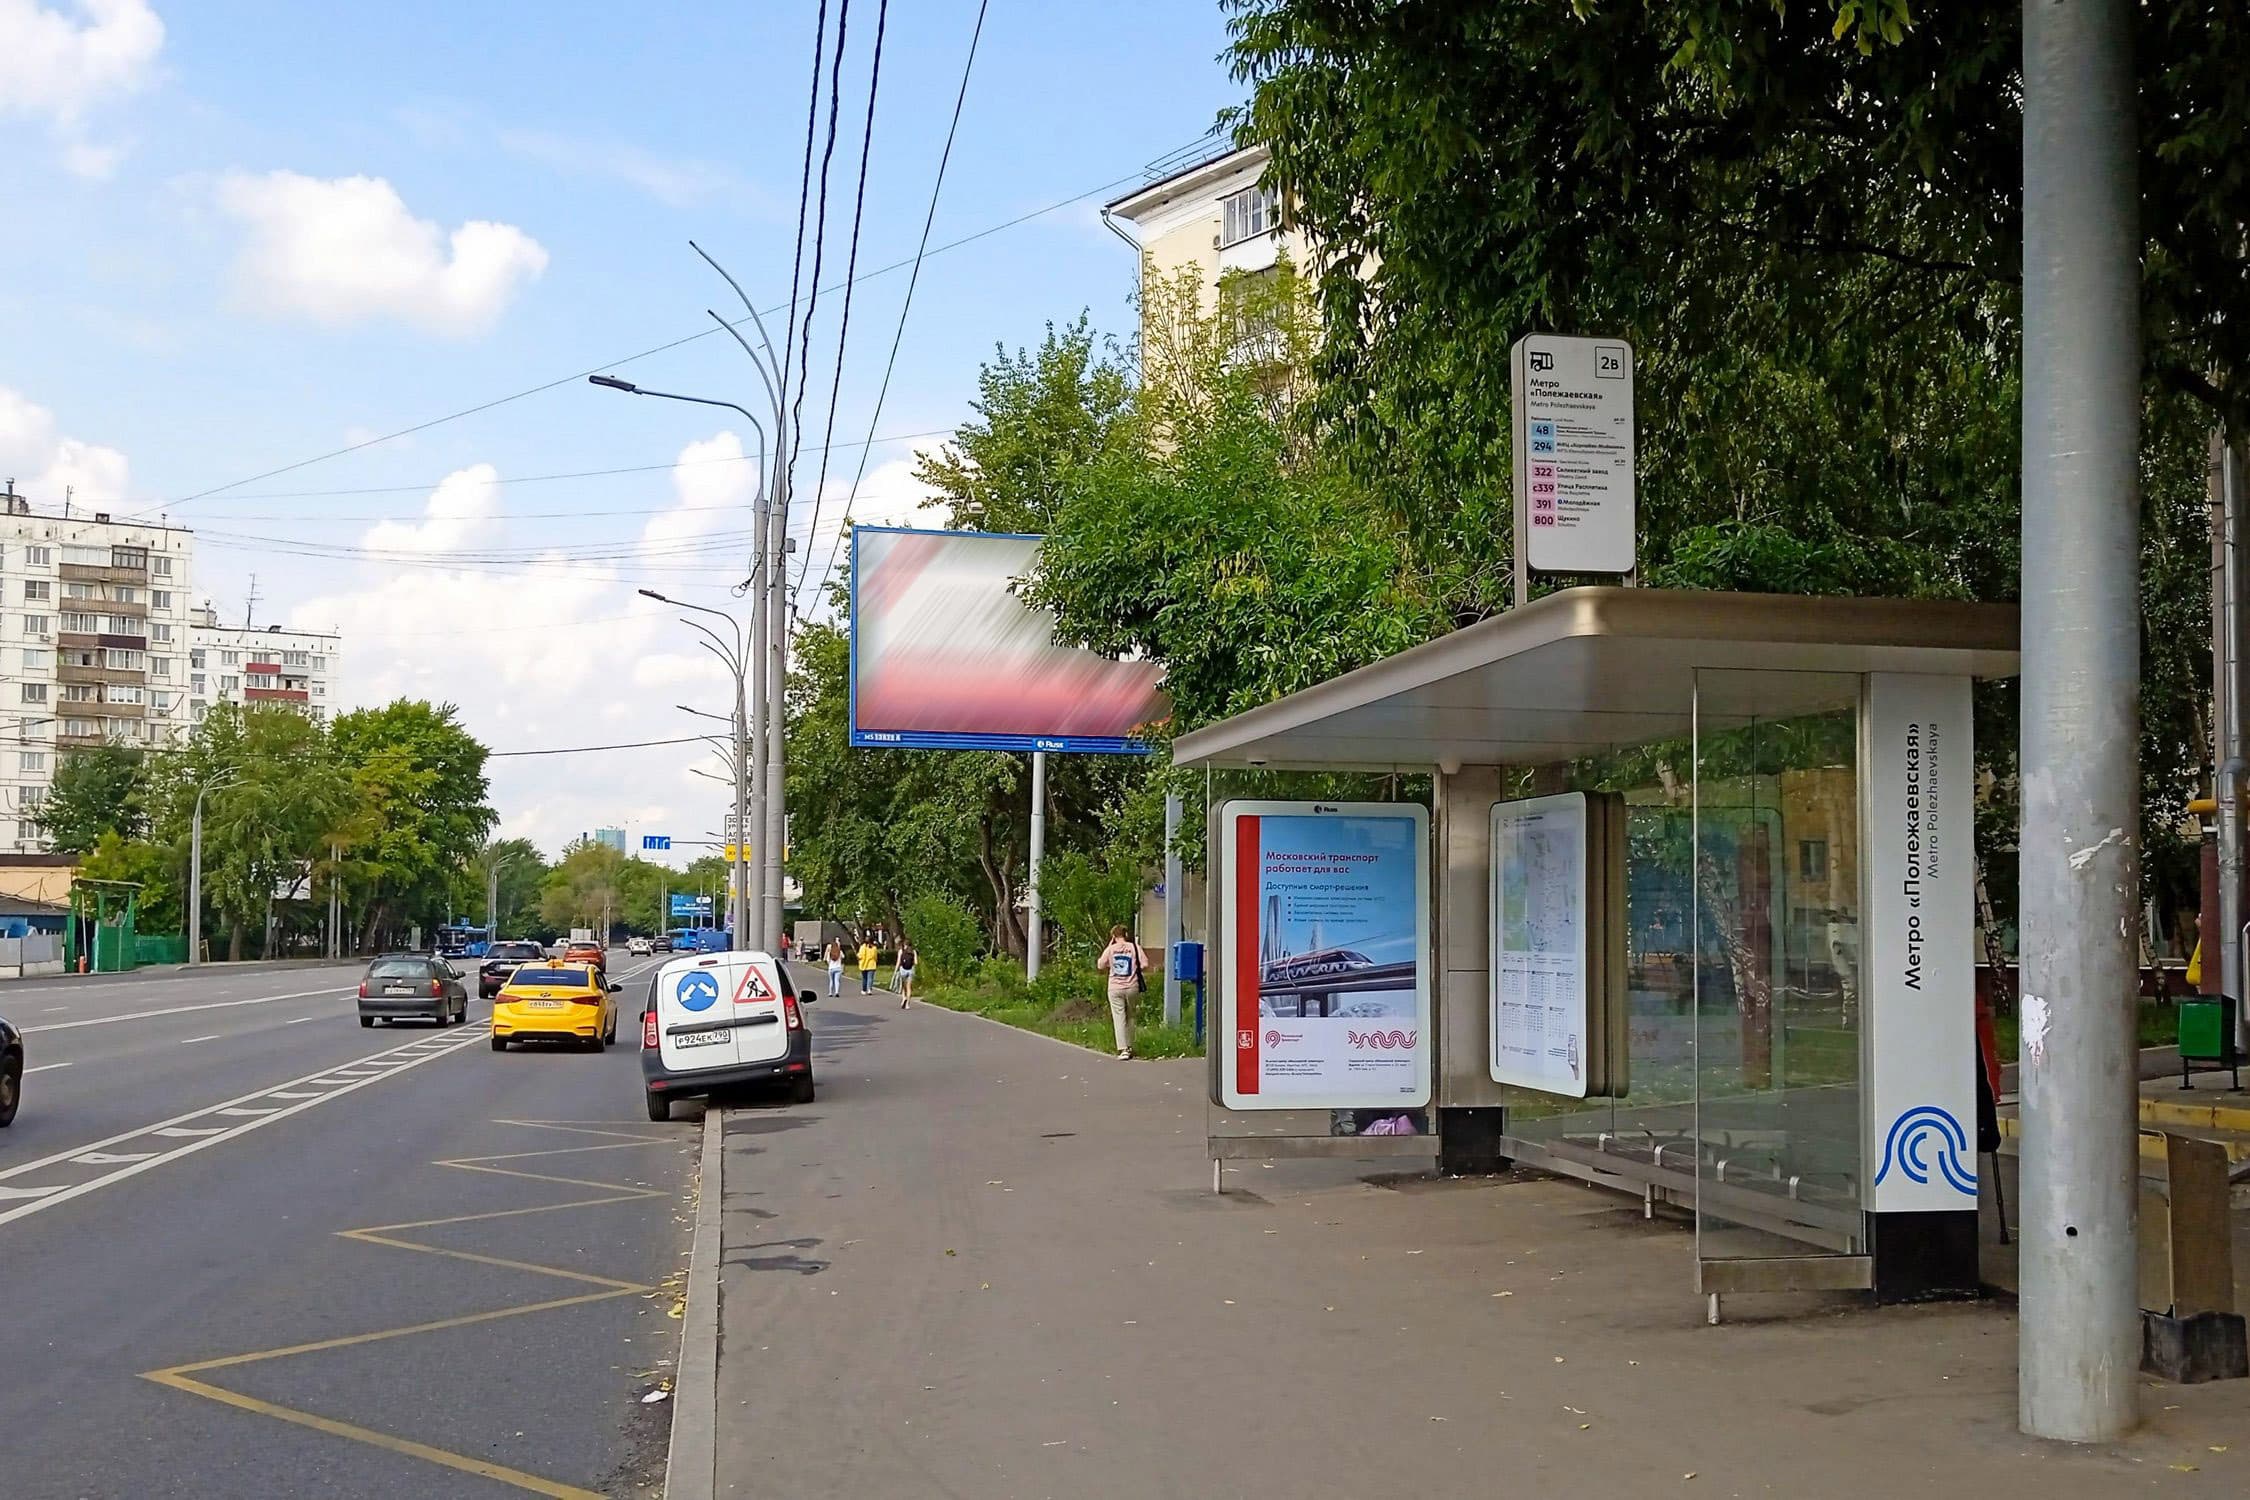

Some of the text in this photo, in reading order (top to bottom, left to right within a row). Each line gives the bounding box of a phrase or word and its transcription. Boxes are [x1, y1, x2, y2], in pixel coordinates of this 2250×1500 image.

[1530, 378, 1560, 389] Метро
[1530, 388, 1603, 400] «Полежаевская»
[1530, 401, 1549, 409] Metro
[1535, 425, 1549, 435] 48
[1534, 441, 1552, 452] 294
[1534, 467, 1552, 477] 322
[1536, 499, 1551, 509] 391
[1534, 515, 1553, 525] 800
[1045, 740, 1064, 749] Russ
[1926, 723, 1939, 879] Metro Polezhaevskaya
[1266, 852, 1379, 864] Московский транспорт
[1904, 723, 1924, 990] Метро «Полежаевская»
[1265, 864, 1311, 874] работает
[1313, 866, 1331, 874] для
[1266, 881, 1369, 891] Доступные смарт-решения
[713, 1030, 728, 1039] 790
